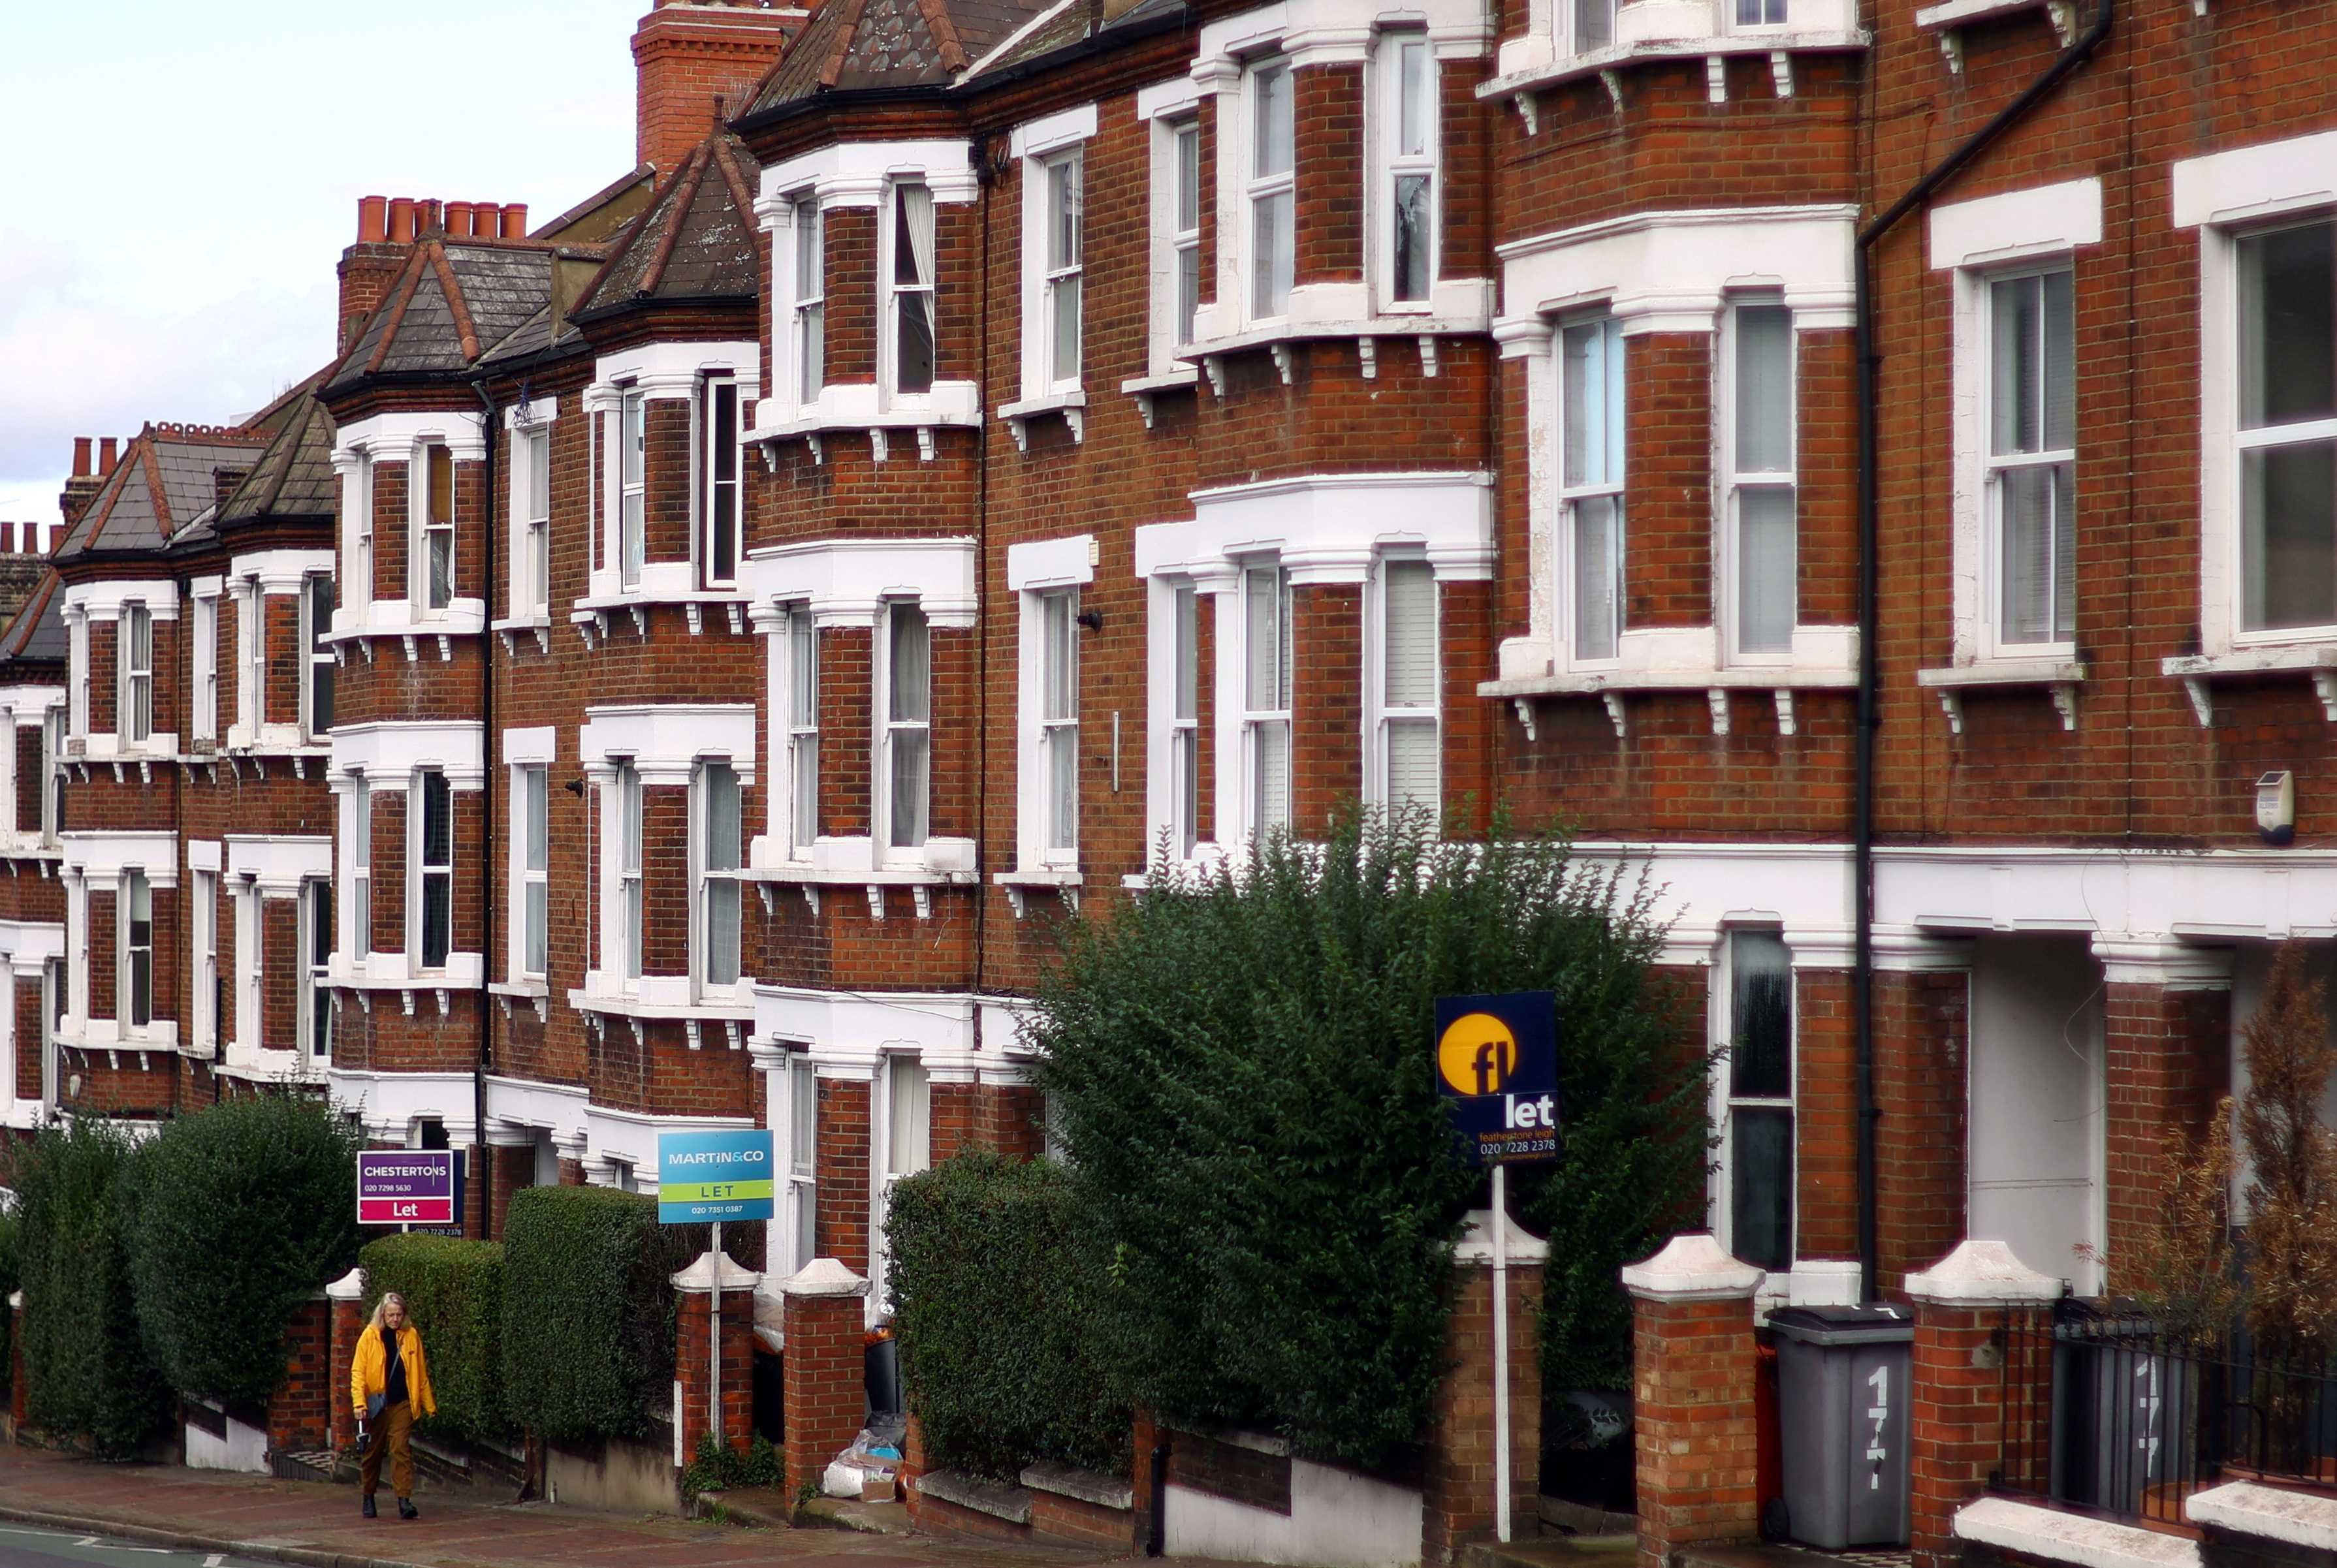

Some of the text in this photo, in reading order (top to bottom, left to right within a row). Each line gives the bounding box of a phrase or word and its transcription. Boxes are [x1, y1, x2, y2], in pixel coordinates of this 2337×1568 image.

[1506, 1094, 1554, 1128] let
[1480, 1129, 1555, 1142] featherstone leigh
[1480, 1144, 1501, 1155] 020
[1531, 1139, 1555, 1152] 2378
[669, 1150, 764, 1165] MARTIN&CO
[364, 1166, 447, 1177] CHESTERTONS
[701, 1185, 733, 1197] LET
[393, 1202, 419, 1217] Let
